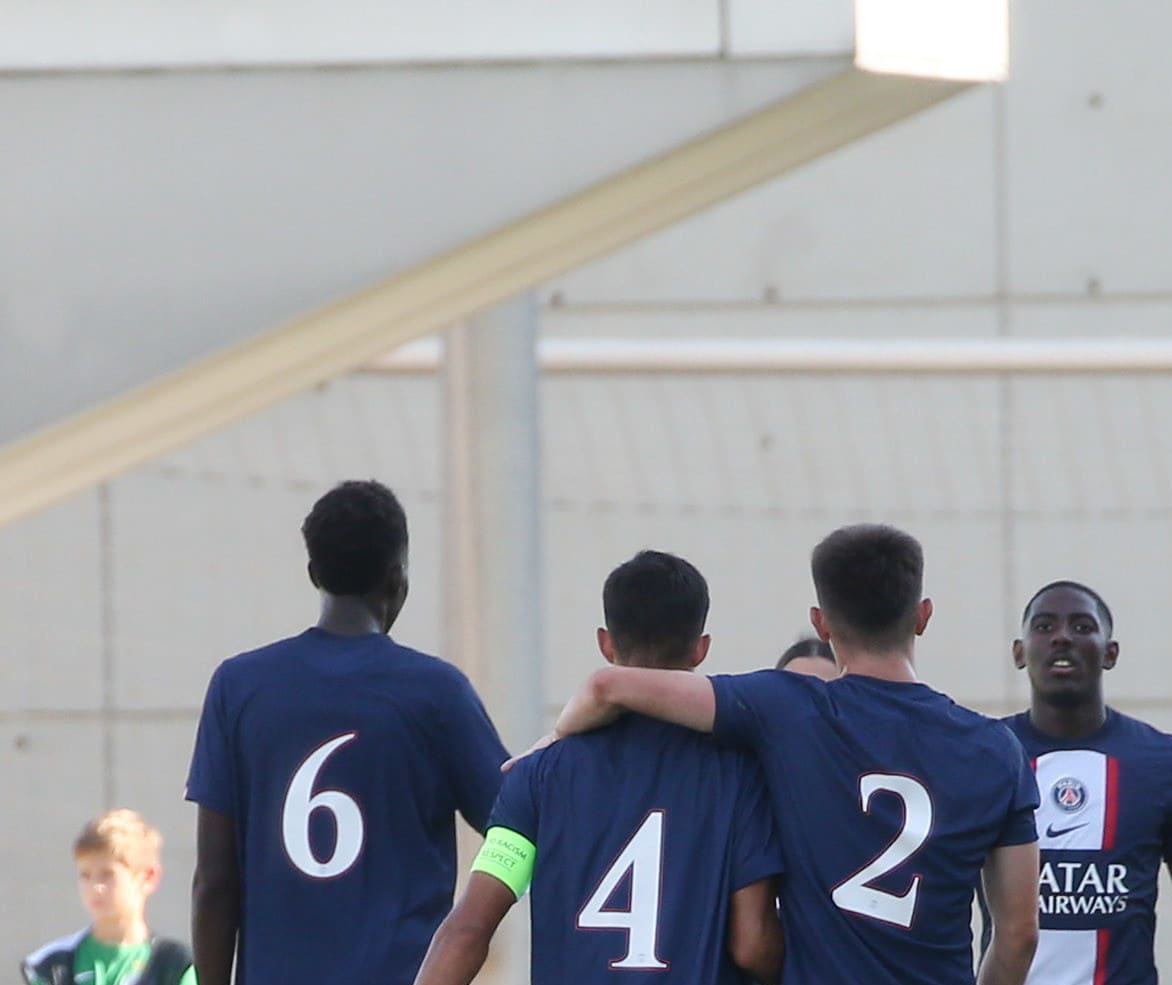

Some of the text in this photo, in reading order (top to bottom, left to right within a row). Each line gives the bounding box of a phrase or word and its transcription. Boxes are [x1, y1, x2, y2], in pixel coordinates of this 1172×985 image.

[282, 732, 365, 879] 6
[831, 772, 934, 928] 2
[482, 850, 516, 868] ESPECT
[576, 809, 670, 971] 4
[1038, 862, 1130, 894] ATAR
[1038, 895, 1128, 915] AIRWAYS
